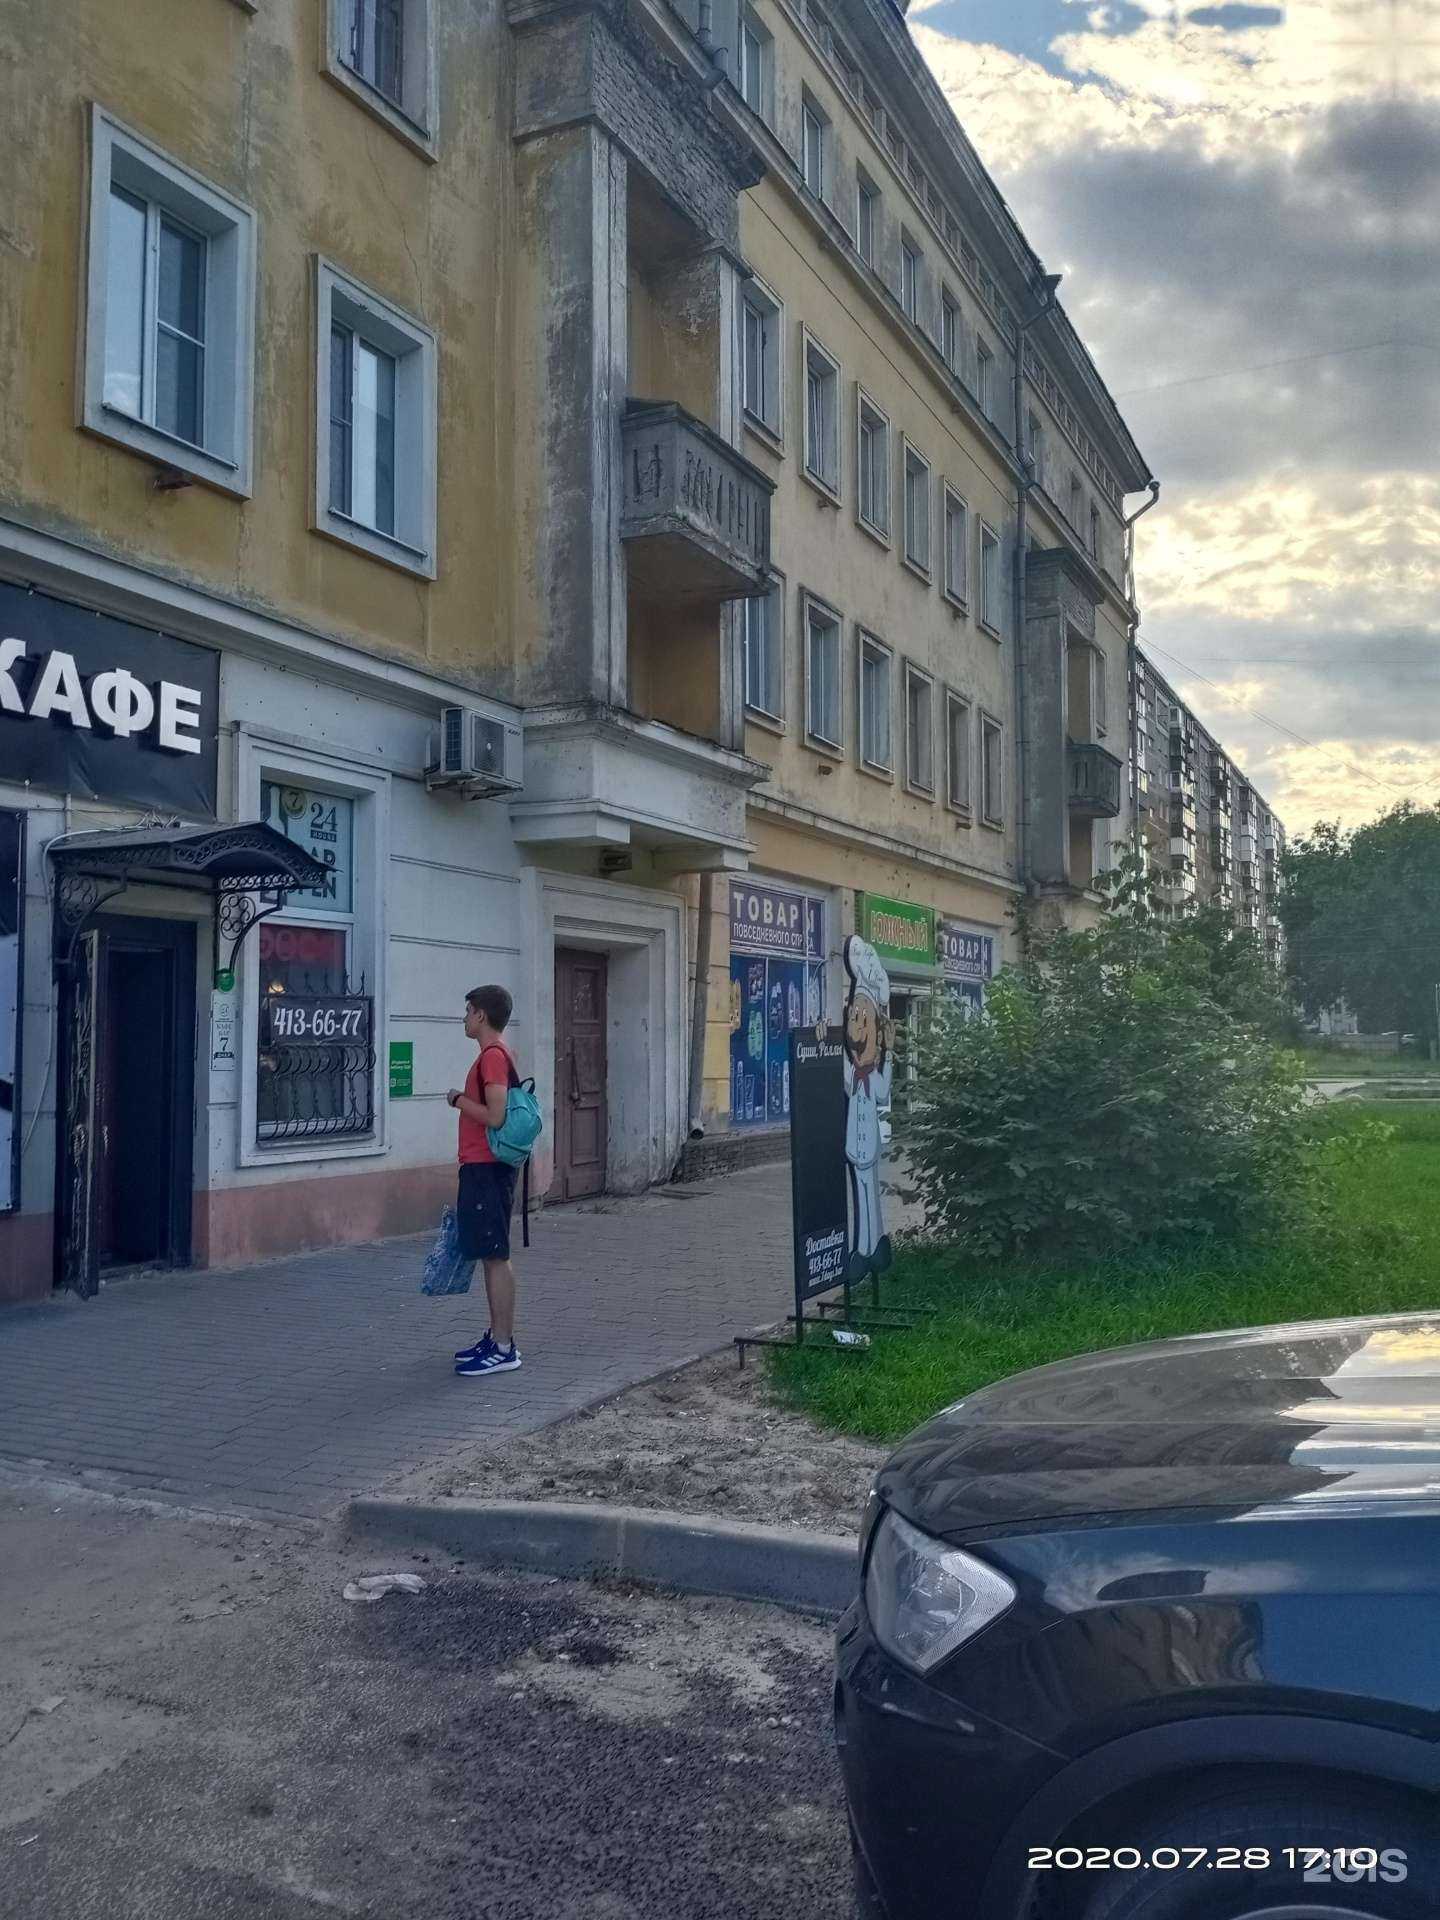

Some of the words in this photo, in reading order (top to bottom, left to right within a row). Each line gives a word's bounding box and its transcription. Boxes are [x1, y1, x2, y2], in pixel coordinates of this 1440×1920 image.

[310, 802, 338, 832] 24
[733, 922, 790, 945] ПОВСЕДНЕВНОГО
[273, 1006, 363, 1036] 413-66-77
[805, 1229, 844, 1256] Доставка
[809, 1247, 842, 1275] 413-66-77
